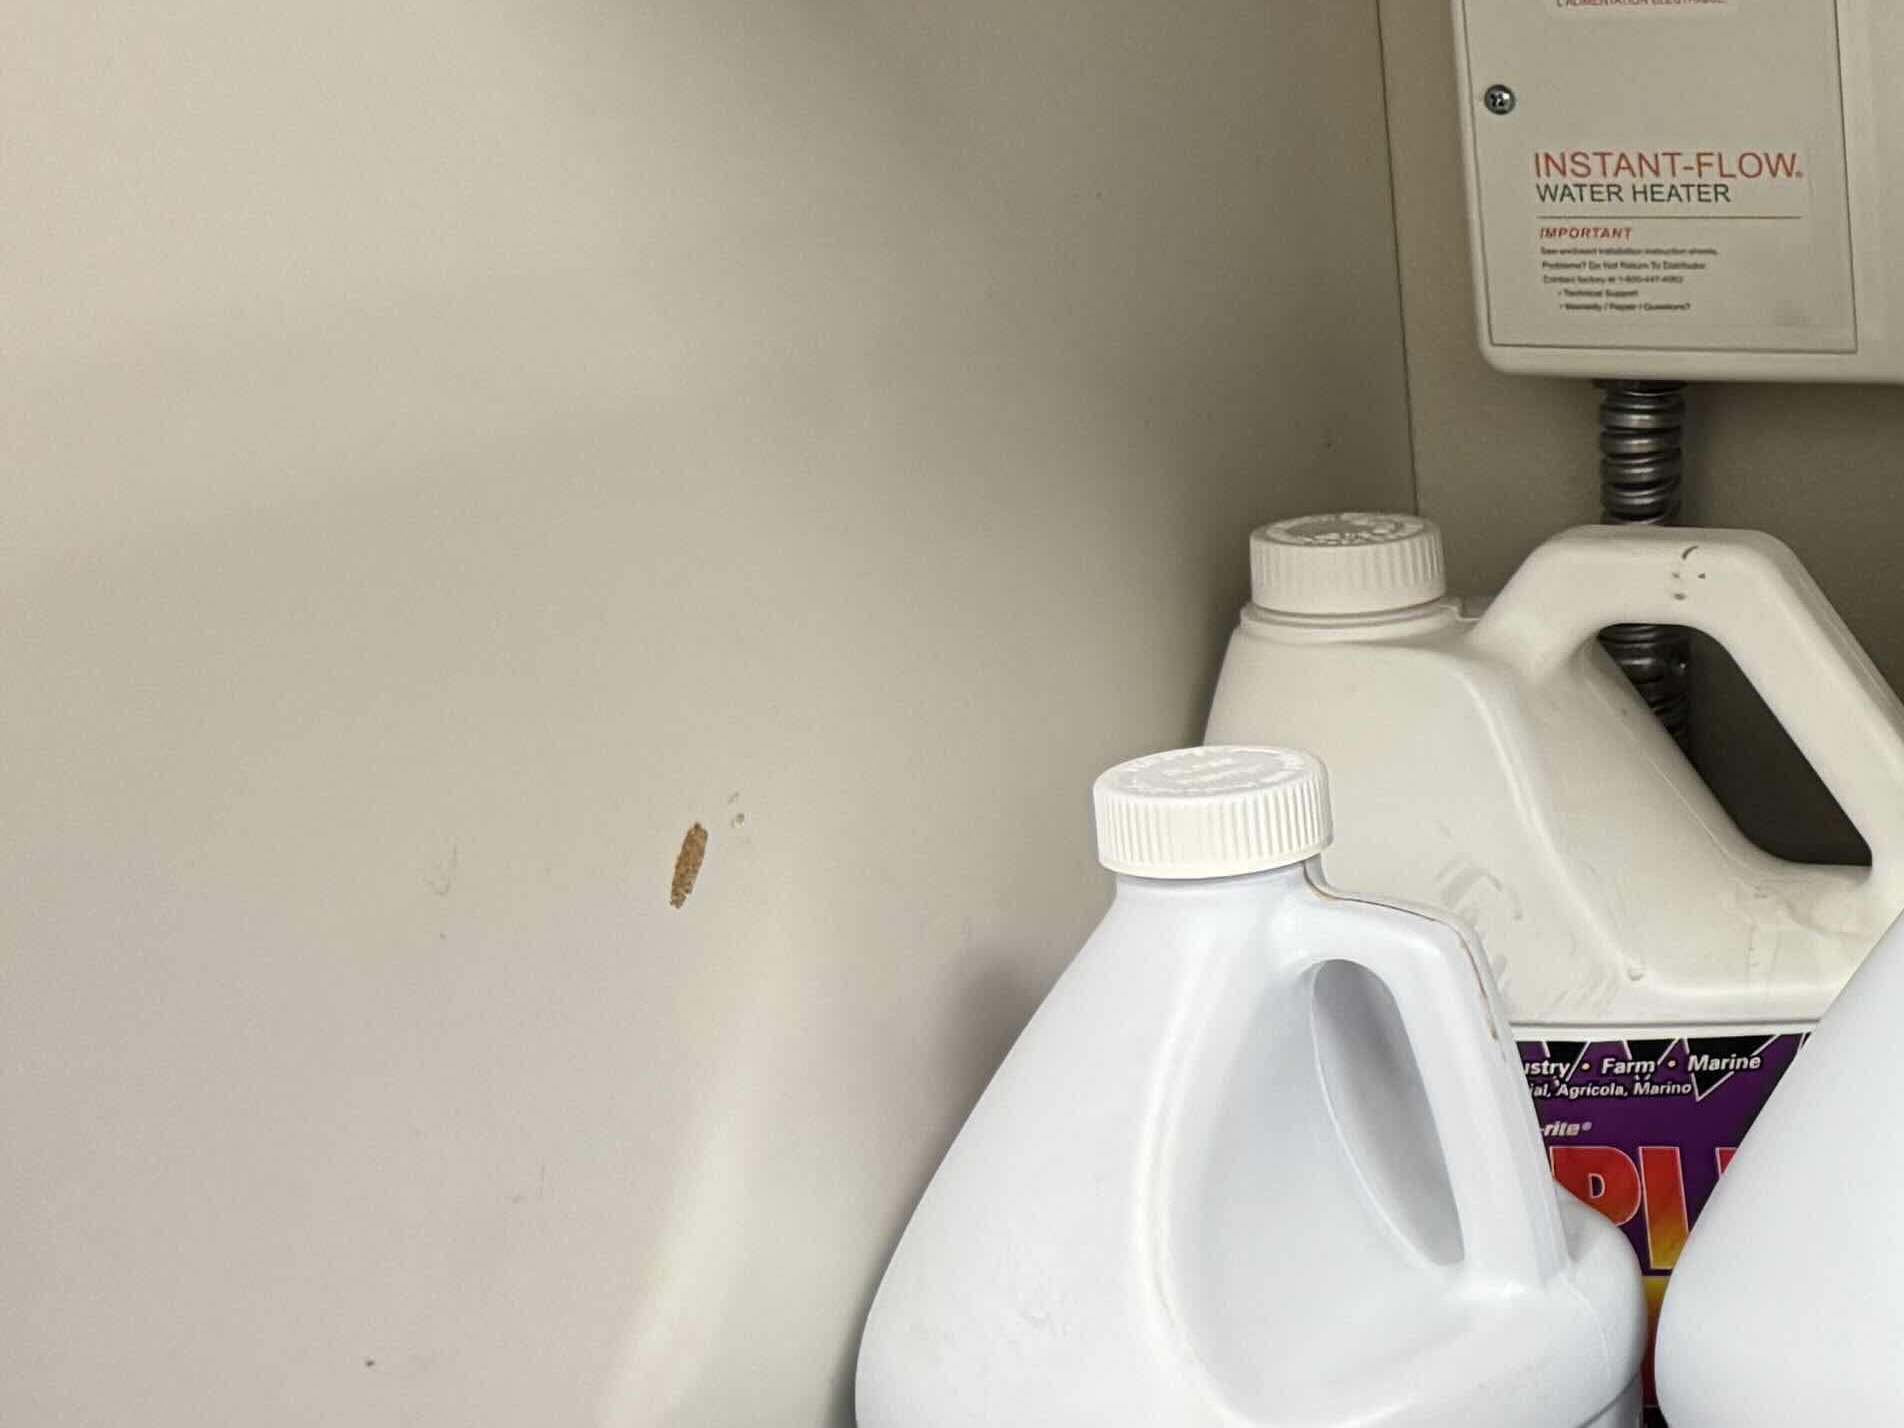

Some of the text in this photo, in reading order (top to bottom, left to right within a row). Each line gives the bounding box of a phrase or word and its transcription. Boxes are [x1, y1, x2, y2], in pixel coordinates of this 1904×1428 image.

[1536, 184, 1731, 203] WATER HEATER
[1540, 227, 1632, 240] IMPORTANT
[1601, 1054, 1761, 1075] Farm Marine
[1634, 1081, 1692, 1096] Marino
